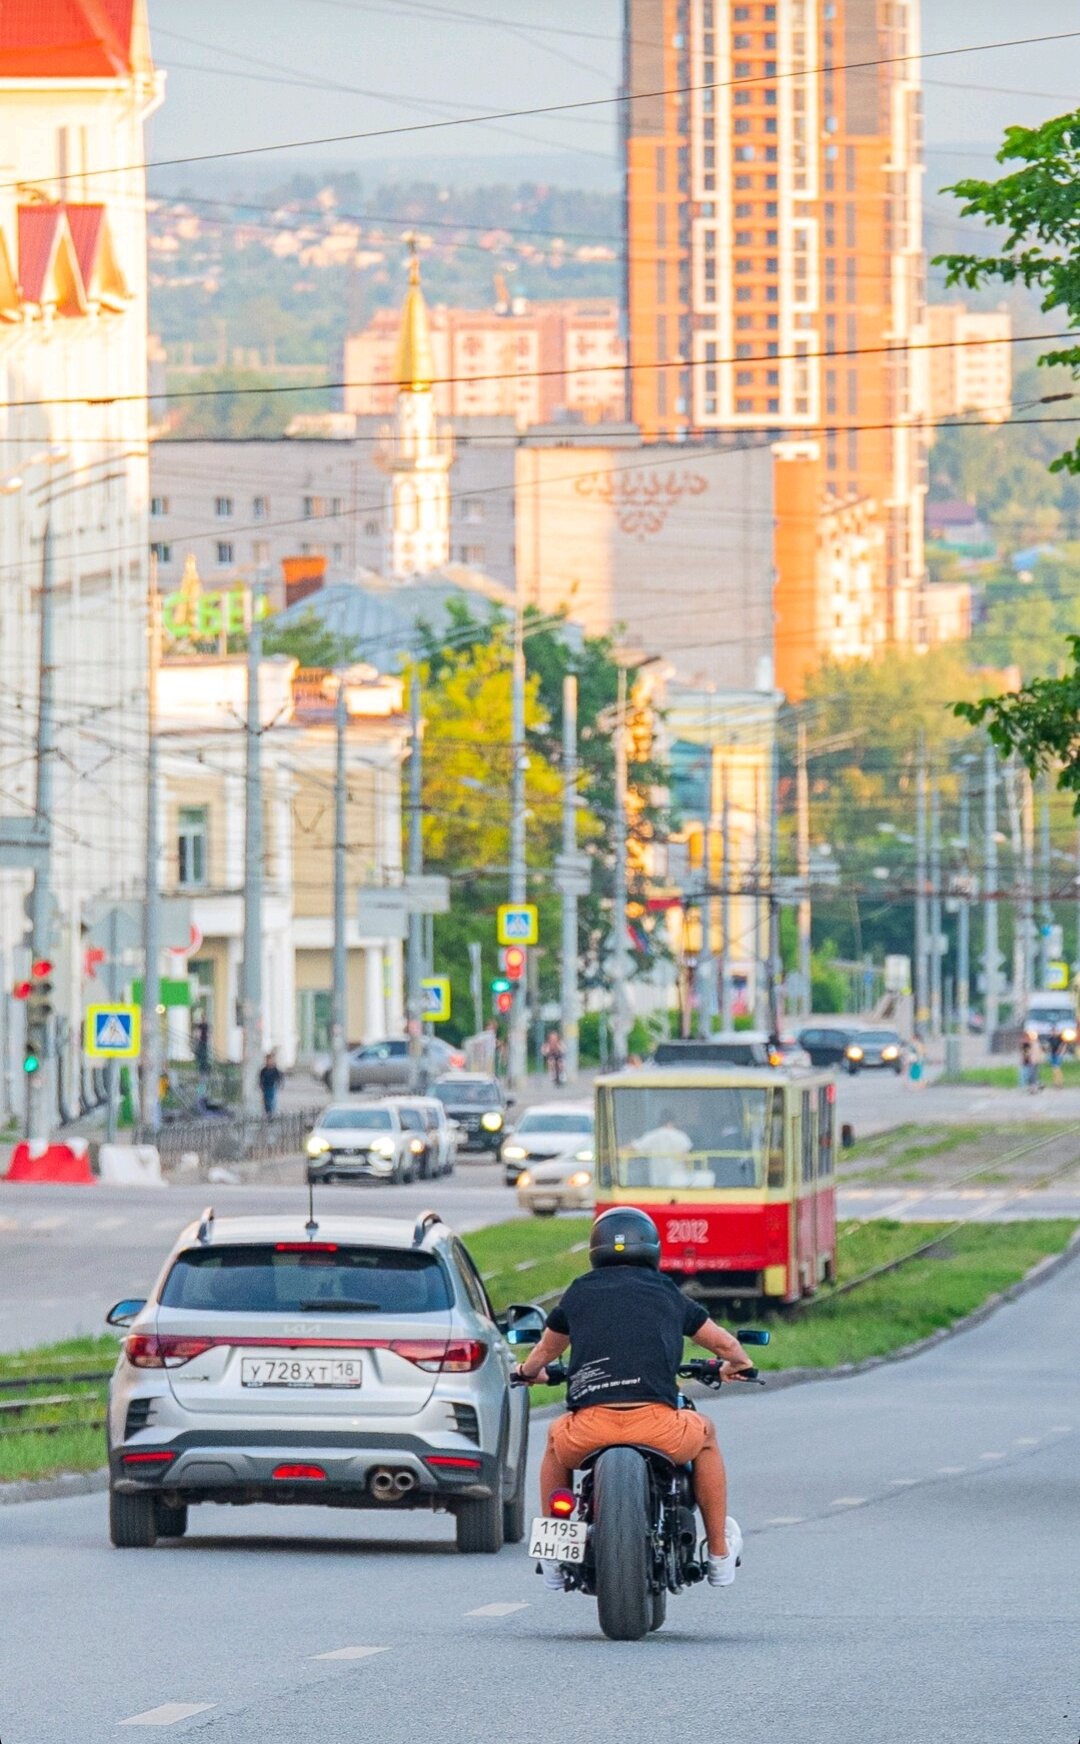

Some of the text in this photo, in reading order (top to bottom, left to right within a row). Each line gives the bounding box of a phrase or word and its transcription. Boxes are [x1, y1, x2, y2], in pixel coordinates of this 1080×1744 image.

[666, 1218, 709, 1244] 2012
[336, 1363, 354, 1376] 18
[540, 1521, 578, 1537] 1195
[562, 1545, 580, 1559] 18
